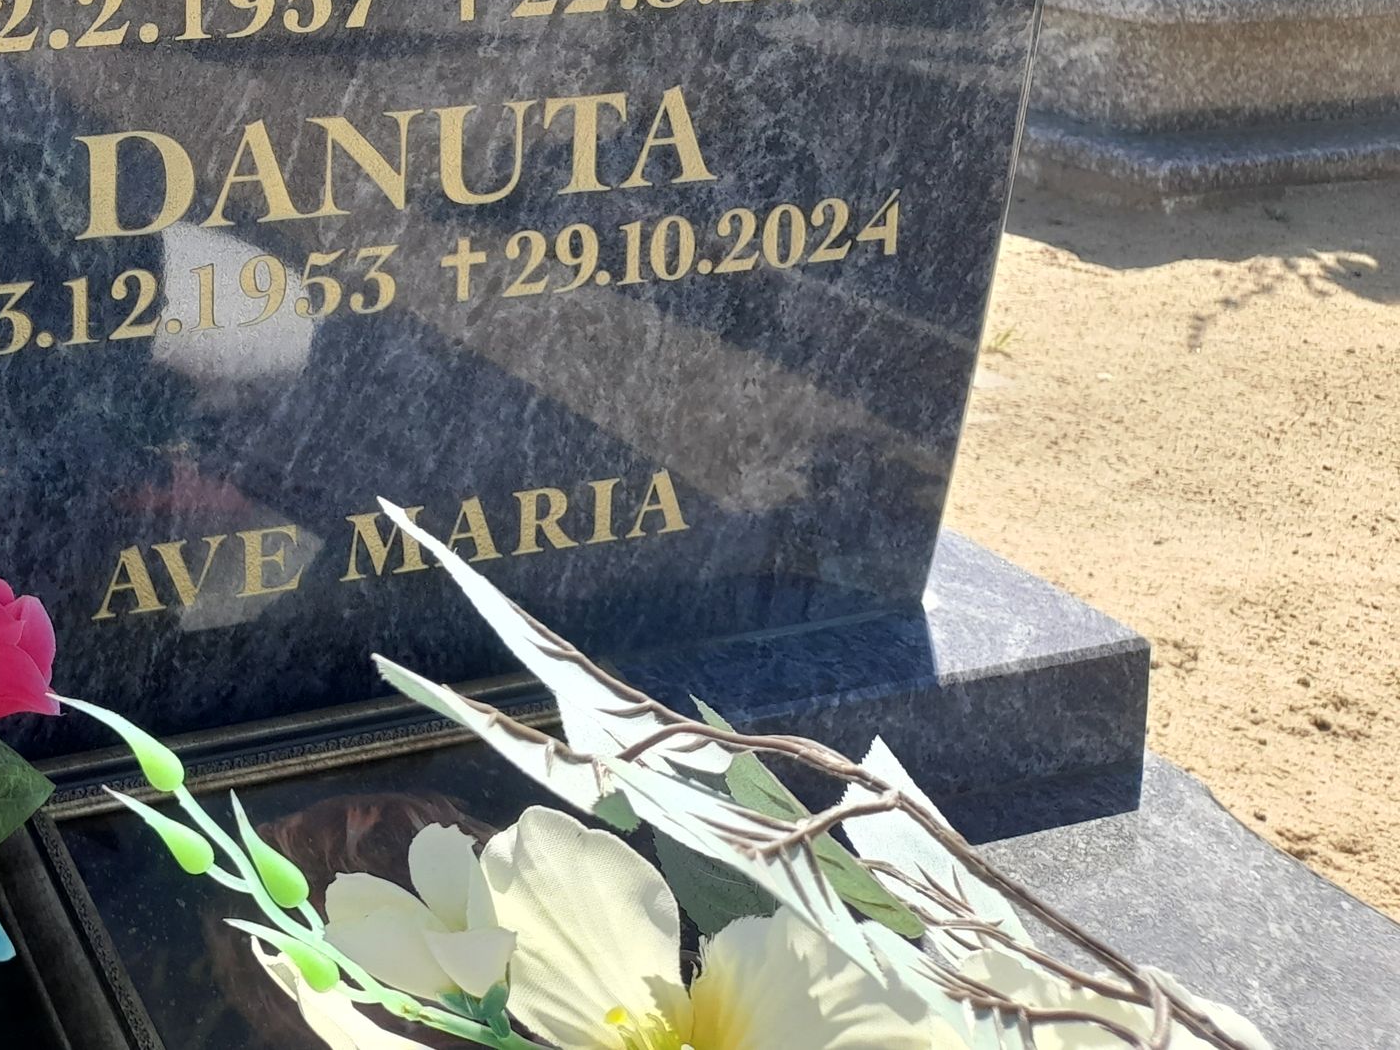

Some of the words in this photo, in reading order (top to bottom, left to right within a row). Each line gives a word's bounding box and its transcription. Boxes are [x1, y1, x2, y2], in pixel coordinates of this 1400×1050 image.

[73, 84, 716, 241] DANUTA
[502, 189, 900, 298] 29.10.2024
[90, 523, 303, 621] AVE
[339, 467, 690, 582] MARIA
